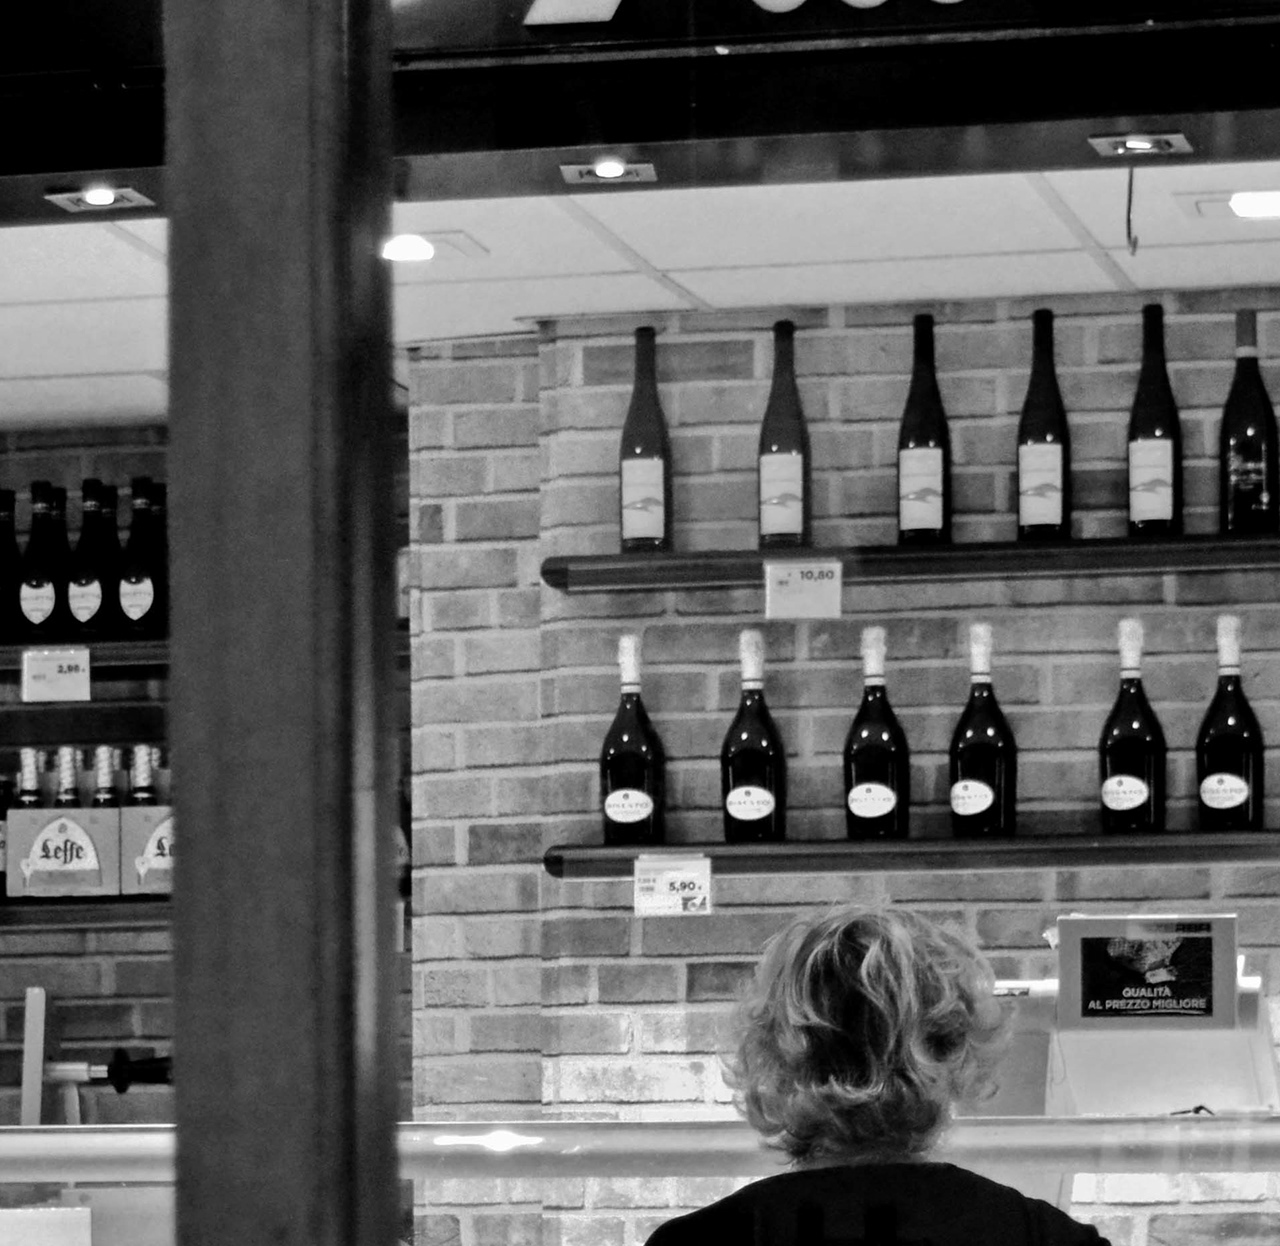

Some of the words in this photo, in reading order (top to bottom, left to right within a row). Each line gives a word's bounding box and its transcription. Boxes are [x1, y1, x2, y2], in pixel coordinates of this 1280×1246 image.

[40, 838, 85, 865] Leffe
[669, 881, 696, 893] 5,90
[1122, 985, 1172, 998] QUALITÀ
[1088, 1001, 1103, 1010] AL
[1105, 1000, 1150, 1010] PREZZO
[1152, 999, 1207, 1009] MIGLIORE
